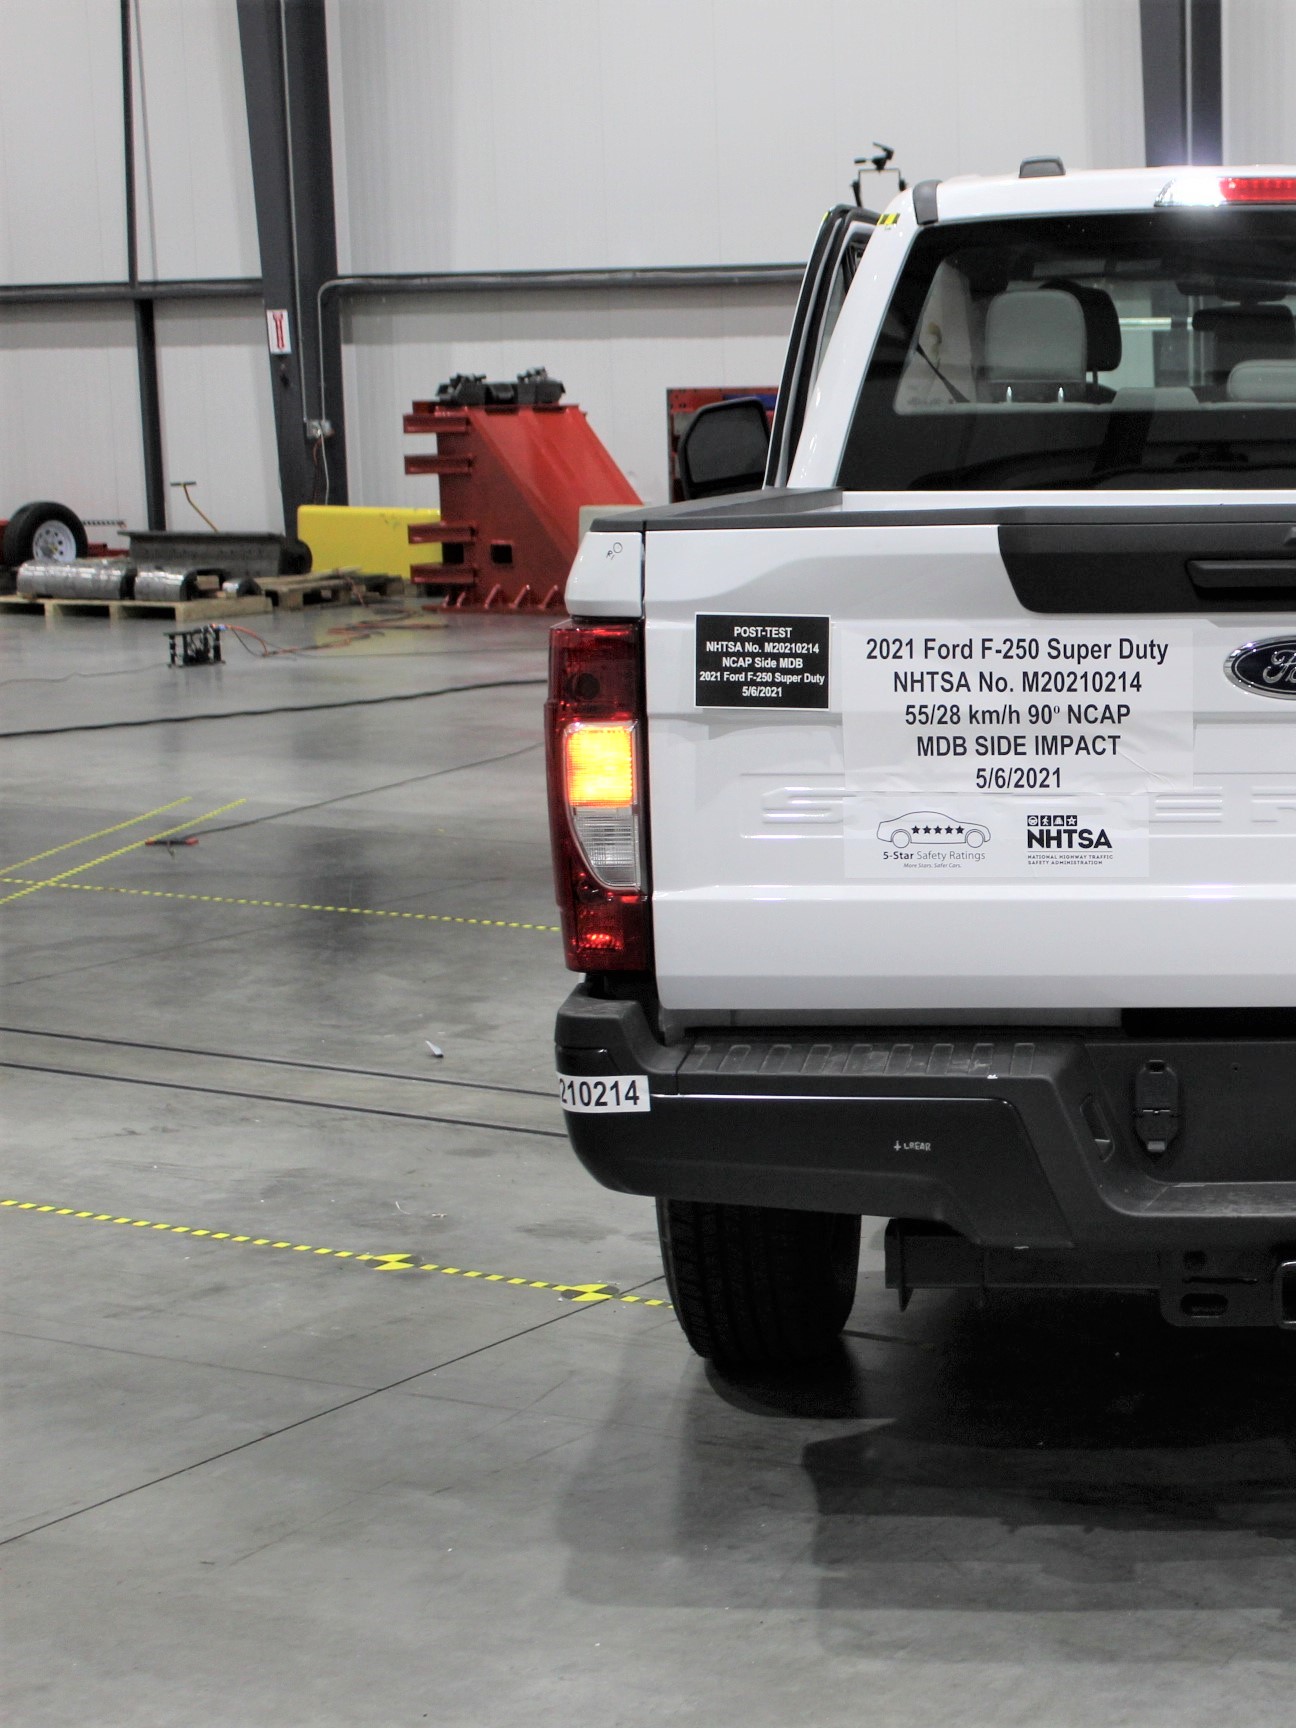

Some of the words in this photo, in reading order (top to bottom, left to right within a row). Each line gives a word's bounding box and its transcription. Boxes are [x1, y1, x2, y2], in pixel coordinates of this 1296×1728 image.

[733, 626, 793, 638] POST-TEST
[706, 641, 743, 653] NHTSA
[744, 641, 762, 653] No.
[764, 642, 820, 654] M20210214
[866, 638, 914, 660] 2021
[924, 638, 973, 660] Ford
[981, 637, 1040, 660] F-250
[1047, 637, 1112, 665] Super
[1119, 638, 1169, 665] Duty
[722, 656, 753, 668] NCAP
[754, 656, 778, 669] Side
[779, 657, 804, 669] MDB
[699, 670, 721, 682] 2021
[723, 671, 746, 682] Ford
[747, 671, 773, 683] F-250
[774, 672, 803, 685] Super
[803, 672, 826, 686] Duty
[893, 671, 972, 693] NHTSA
[979, 671, 1014, 693] No.
[1022, 671, 1142, 693] M20210214
[741, 685, 783, 698] 5/6/2021
[904, 703, 962, 726] 55/28
[968, 703, 1021, 726] km/h
[1067, 703, 1132, 725] NCAP
[917, 735, 969, 757] MDB
[975, 735, 1027, 757] SIDE
[1034, 734, 1122, 756] IMPACT
[975, 767, 1062, 789] 5/6/2021
[1027, 828, 1113, 849] NHTSA
[882, 850, 915, 860] 5-Star
[916, 850, 947, 862] Safety
[949, 850, 986, 862] Ratings
